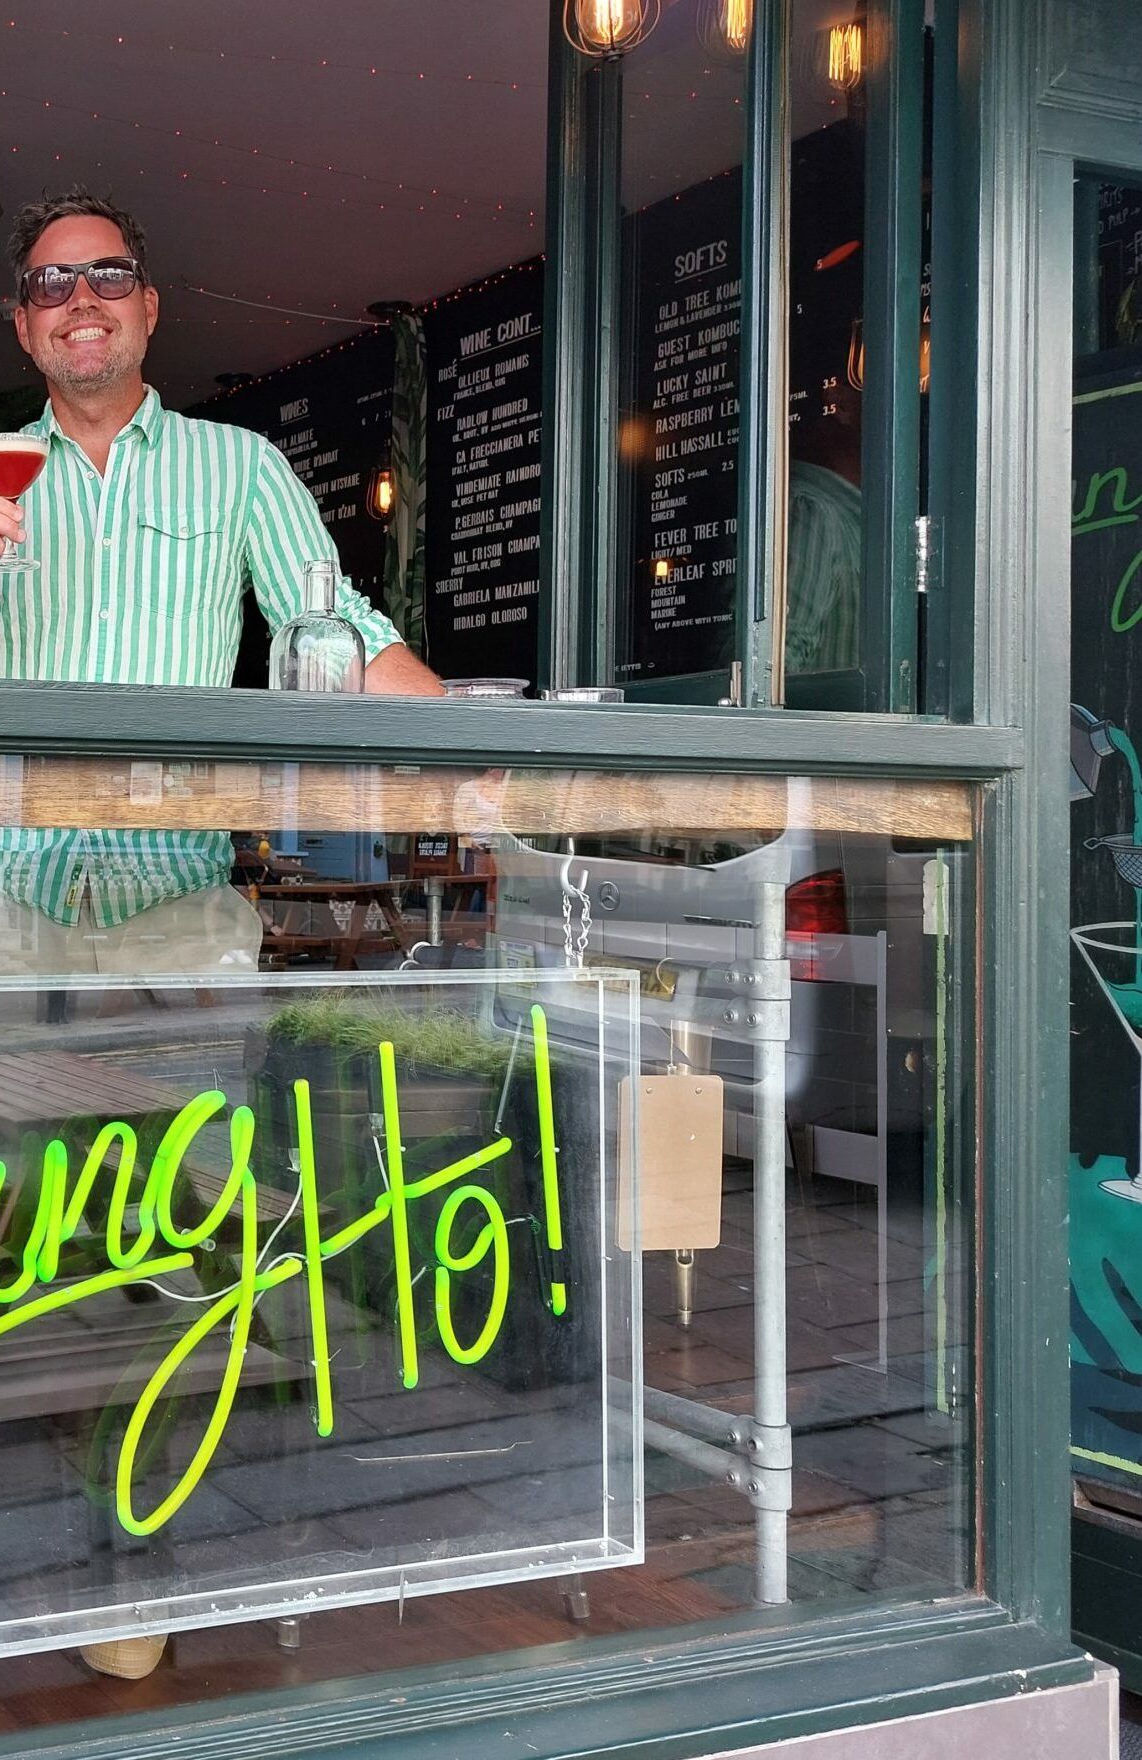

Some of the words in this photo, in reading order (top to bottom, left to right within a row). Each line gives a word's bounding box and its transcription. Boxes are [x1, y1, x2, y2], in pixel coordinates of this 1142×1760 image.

[675, 240, 727, 277] SOFTS
[659, 301, 678, 320] OLD
[685, 290, 710, 312] TREE
[796, 304, 802, 315] 5
[654, 317, 678, 334] LEMON
[686, 304, 721, 324] LAVENDER
[460, 327, 492, 356] WINE
[498, 312, 541, 342] CONT...
[658, 334, 691, 358] GUEST
[698, 319, 740, 346] KOMBUC
[653, 359, 667, 372] ASK
[670, 354, 684, 367] FOR
[687, 347, 708, 361] MORE
[711, 341, 728, 354] INFO
[438, 358, 458, 383] ROSÉ
[459, 366, 490, 389] OLLIEUX
[657, 373, 689, 396] LUCKY
[695, 362, 727, 385] SAINT
[822, 376, 837, 389] 3.5
[671, 391, 689, 405] FREE
[692, 385, 712, 398] BEER
[280, 398, 309, 422] WINES
[438, 404, 455, 421] FIZZ
[492, 398, 528, 421] HUNDRED
[655, 405, 714, 434] RASPBERRY
[822, 403, 837, 416] 3.5
[655, 442, 678, 462] HILL
[680, 431, 724, 455] HASSALL
[456, 473, 502, 497] VINDEMIATE
[505, 463, 541, 484] RAINDRO
[655, 468, 685, 488] SOFTS
[651, 489, 669, 501] COLA
[651, 496, 688, 511] LEMONADE
[651, 509, 675, 522] GINGER
[654, 528, 687, 547] FEVER
[693, 521, 720, 541] TREE
[724, 518, 738, 535] TO
[454, 550, 468, 565] VAL
[472, 543, 502, 562] FRISON
[676, 545, 692, 556] MED
[435, 577, 464, 594] SHERRY
[651, 585, 677, 598] FOREST
[453, 588, 490, 607] GABRIELA
[651, 595, 686, 609] MOUNTAIN
[454, 613, 486, 631] HIDALGO
[491, 606, 528, 625] OLOROSO
[651, 607, 677, 619] MARINE
[671, 618, 694, 628] ABOVE
[695, 616, 712, 625] WITH
[713, 614, 733, 623] TONIC
[295, 1003, 567, 1438] Ho!
